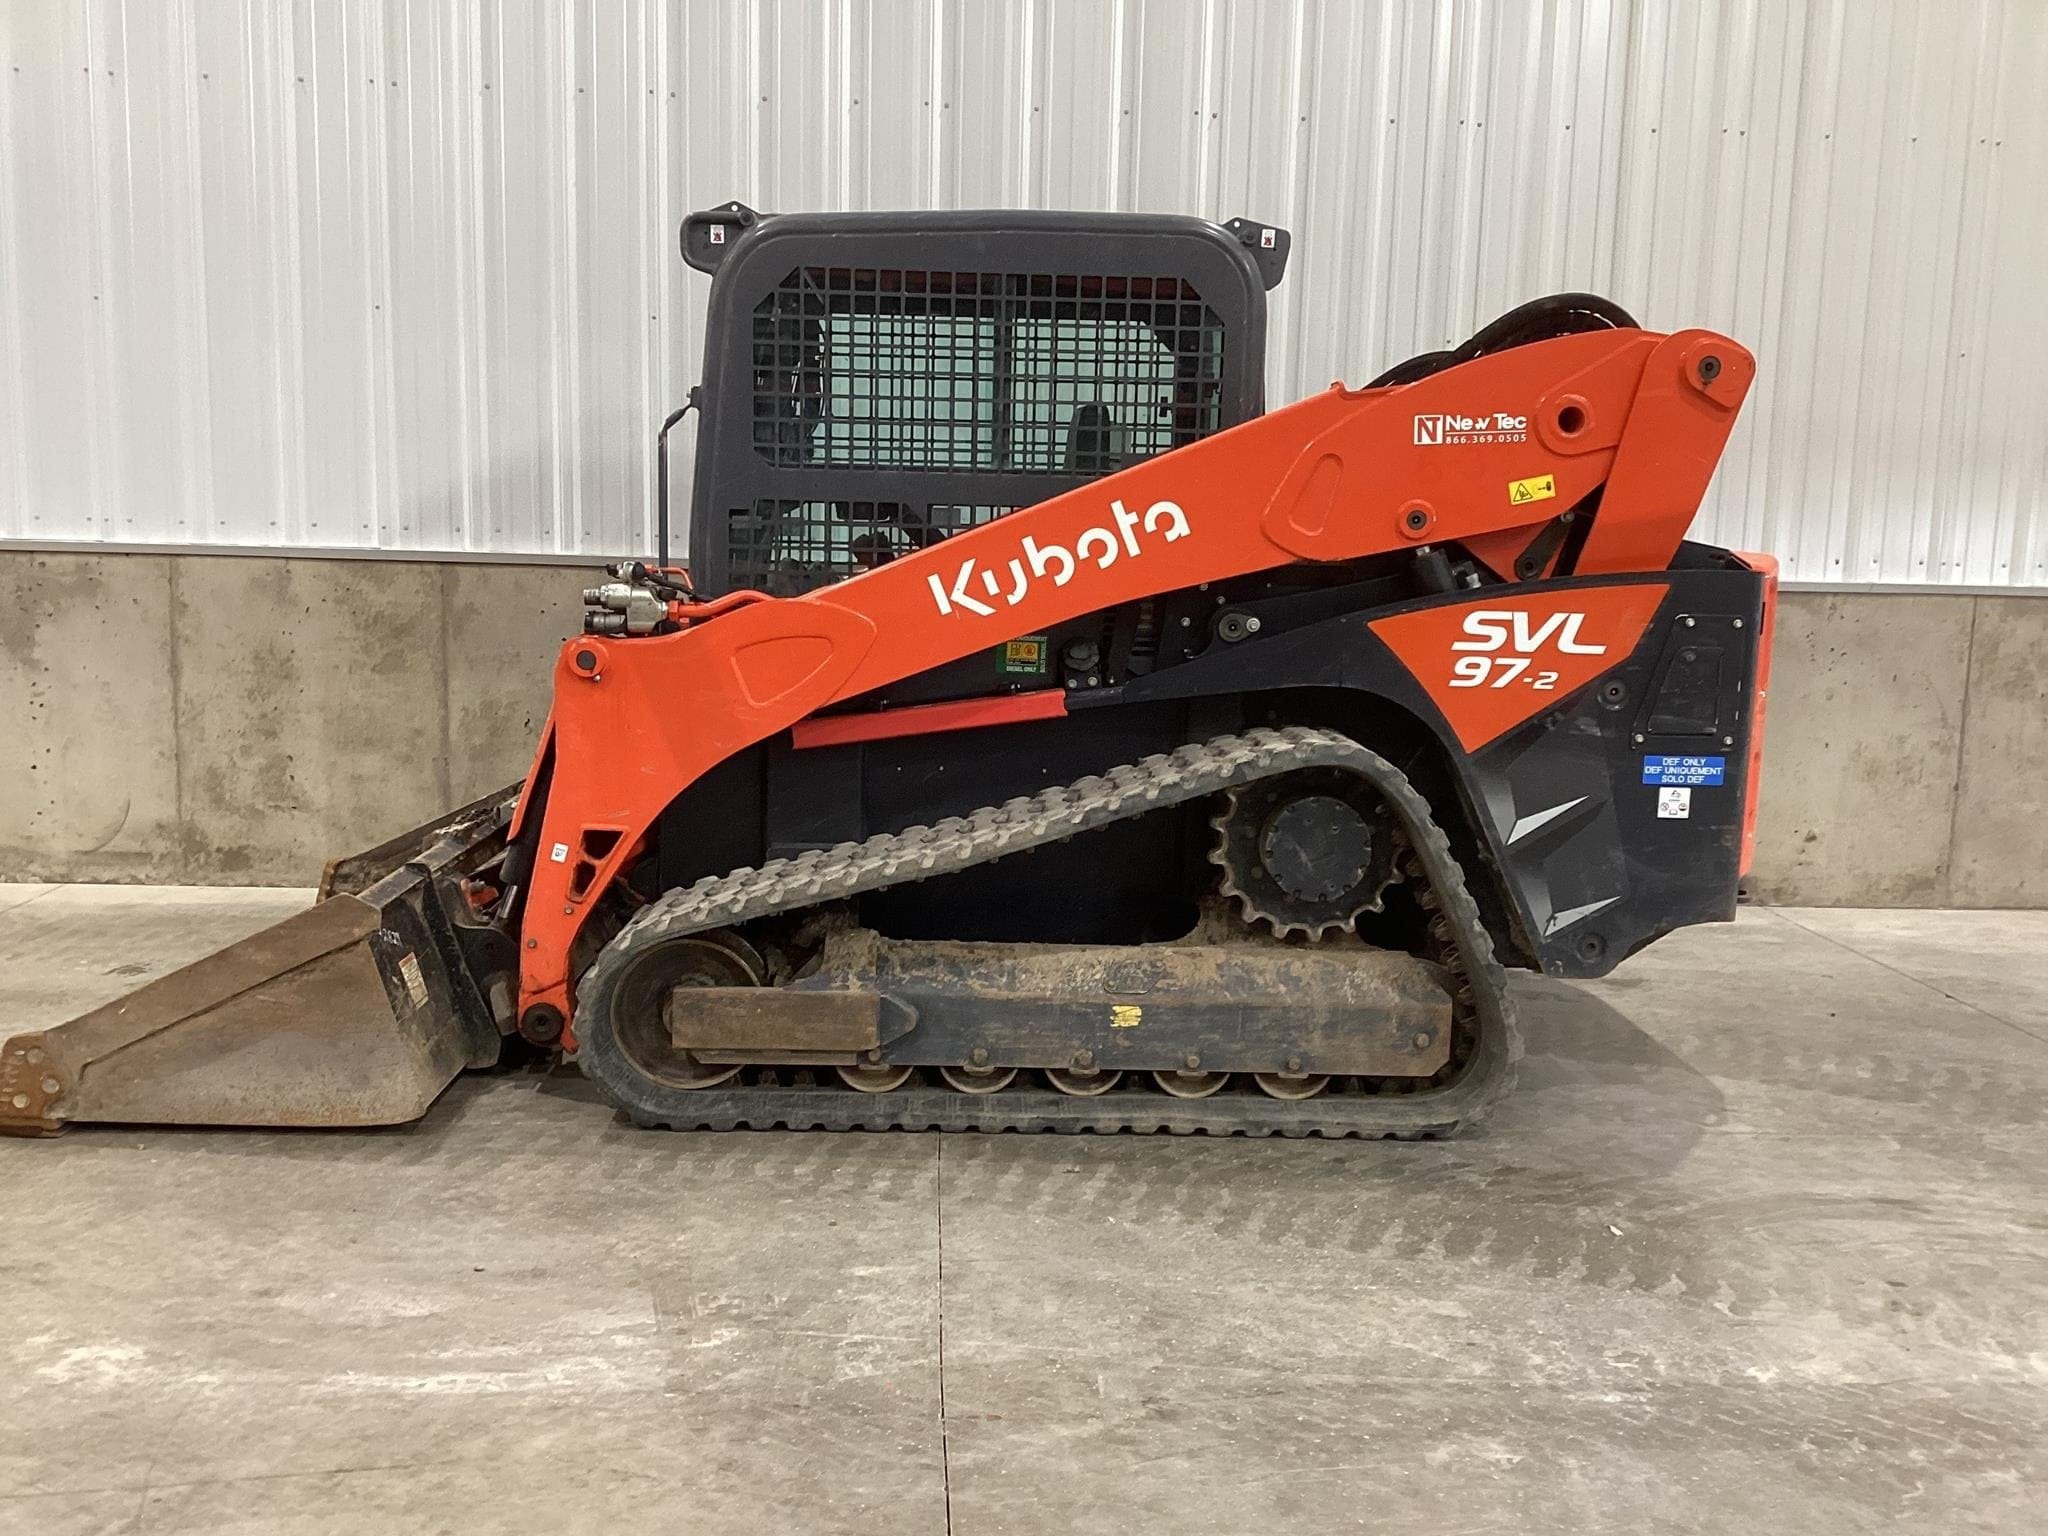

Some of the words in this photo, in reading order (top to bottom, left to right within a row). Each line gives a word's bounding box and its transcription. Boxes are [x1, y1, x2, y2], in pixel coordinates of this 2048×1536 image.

[1445, 434, 1527, 444] 866.369.0505
[927, 500, 1191, 617] Kubota
[1451, 611, 1607, 655] SVL
[1448, 656, 1559, 690] 97-2
[1662, 757, 1681, 766] DEF
[1683, 758, 1707, 767] ONLY
[1645, 766, 1663, 774] DEF
[1664, 767, 1723, 775] UNIQUEMENT
[1661, 775, 1685, 783] SOLO
[1687, 775, 1705, 783] DEF
